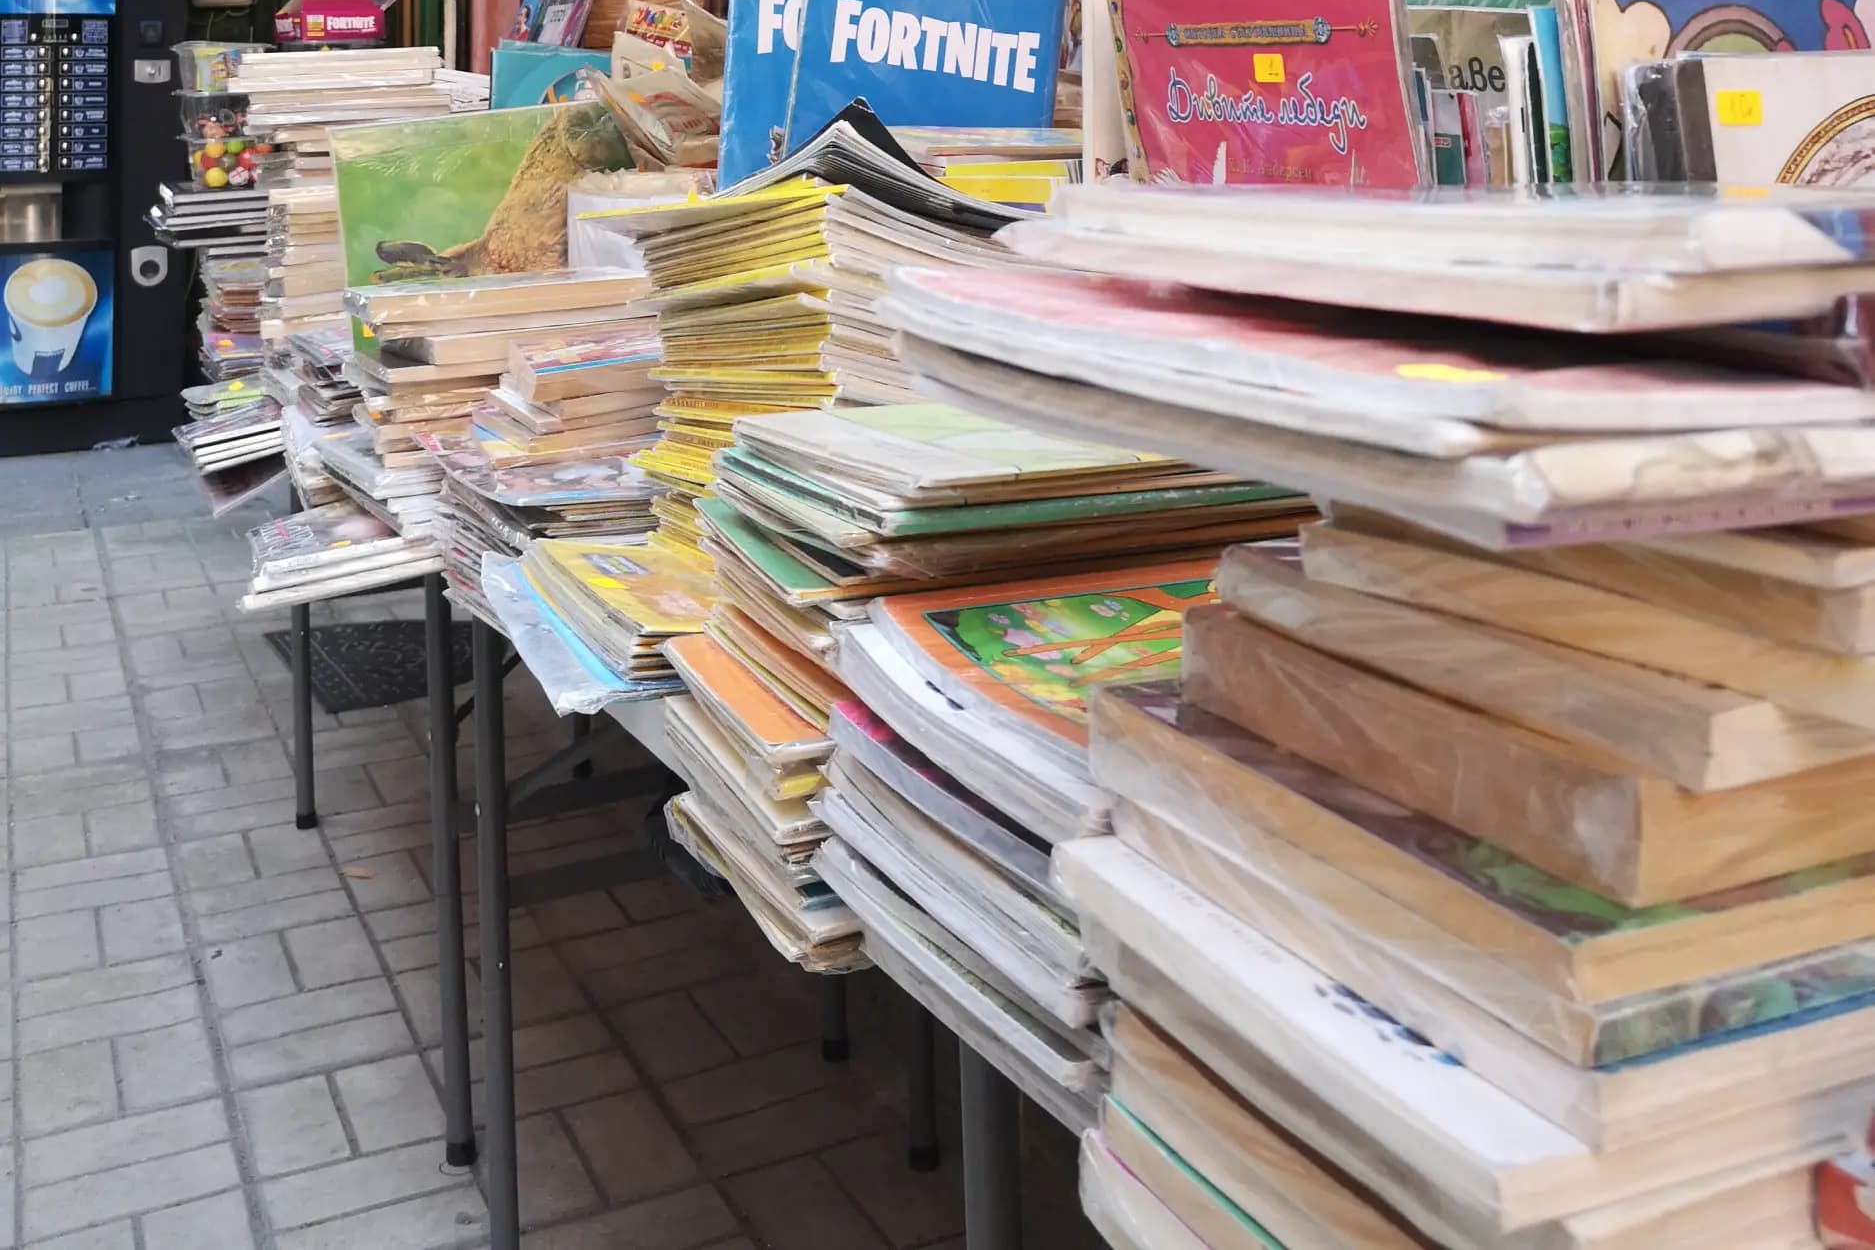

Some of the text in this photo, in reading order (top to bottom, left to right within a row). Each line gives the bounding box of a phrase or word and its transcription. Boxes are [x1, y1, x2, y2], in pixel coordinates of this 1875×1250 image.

[327, 16, 375, 30] FORTNITE
[1167, 64, 1367, 154] Дивите лебеди
